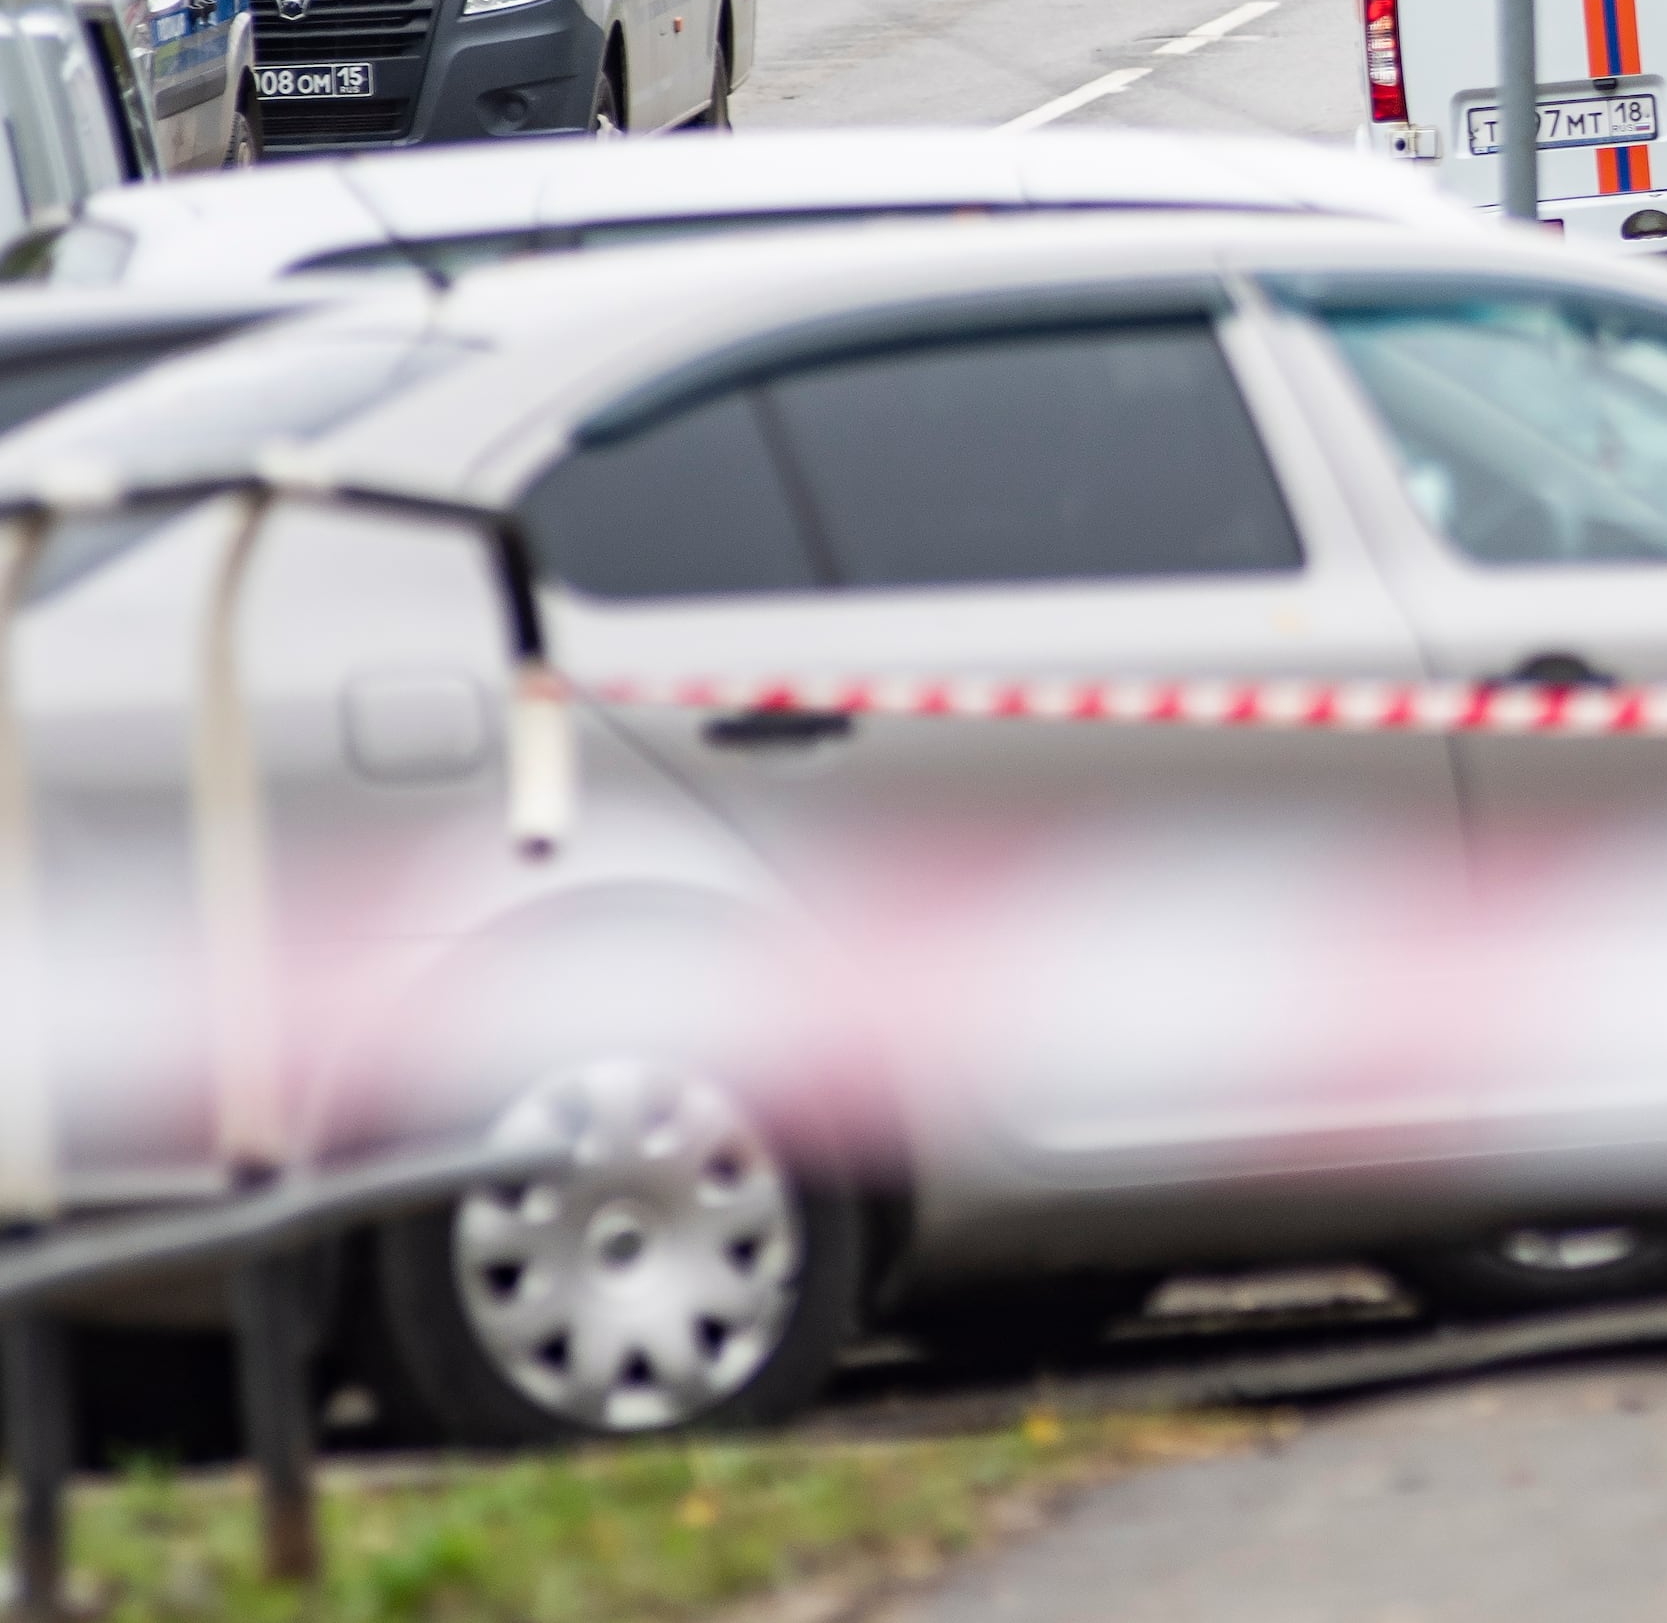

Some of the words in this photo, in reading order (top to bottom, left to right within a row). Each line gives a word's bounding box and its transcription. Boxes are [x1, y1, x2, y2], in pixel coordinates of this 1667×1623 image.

[337, 66, 363, 86] 15
[340, 86, 360, 94] RUS
[1614, 101, 1643, 124] 18
